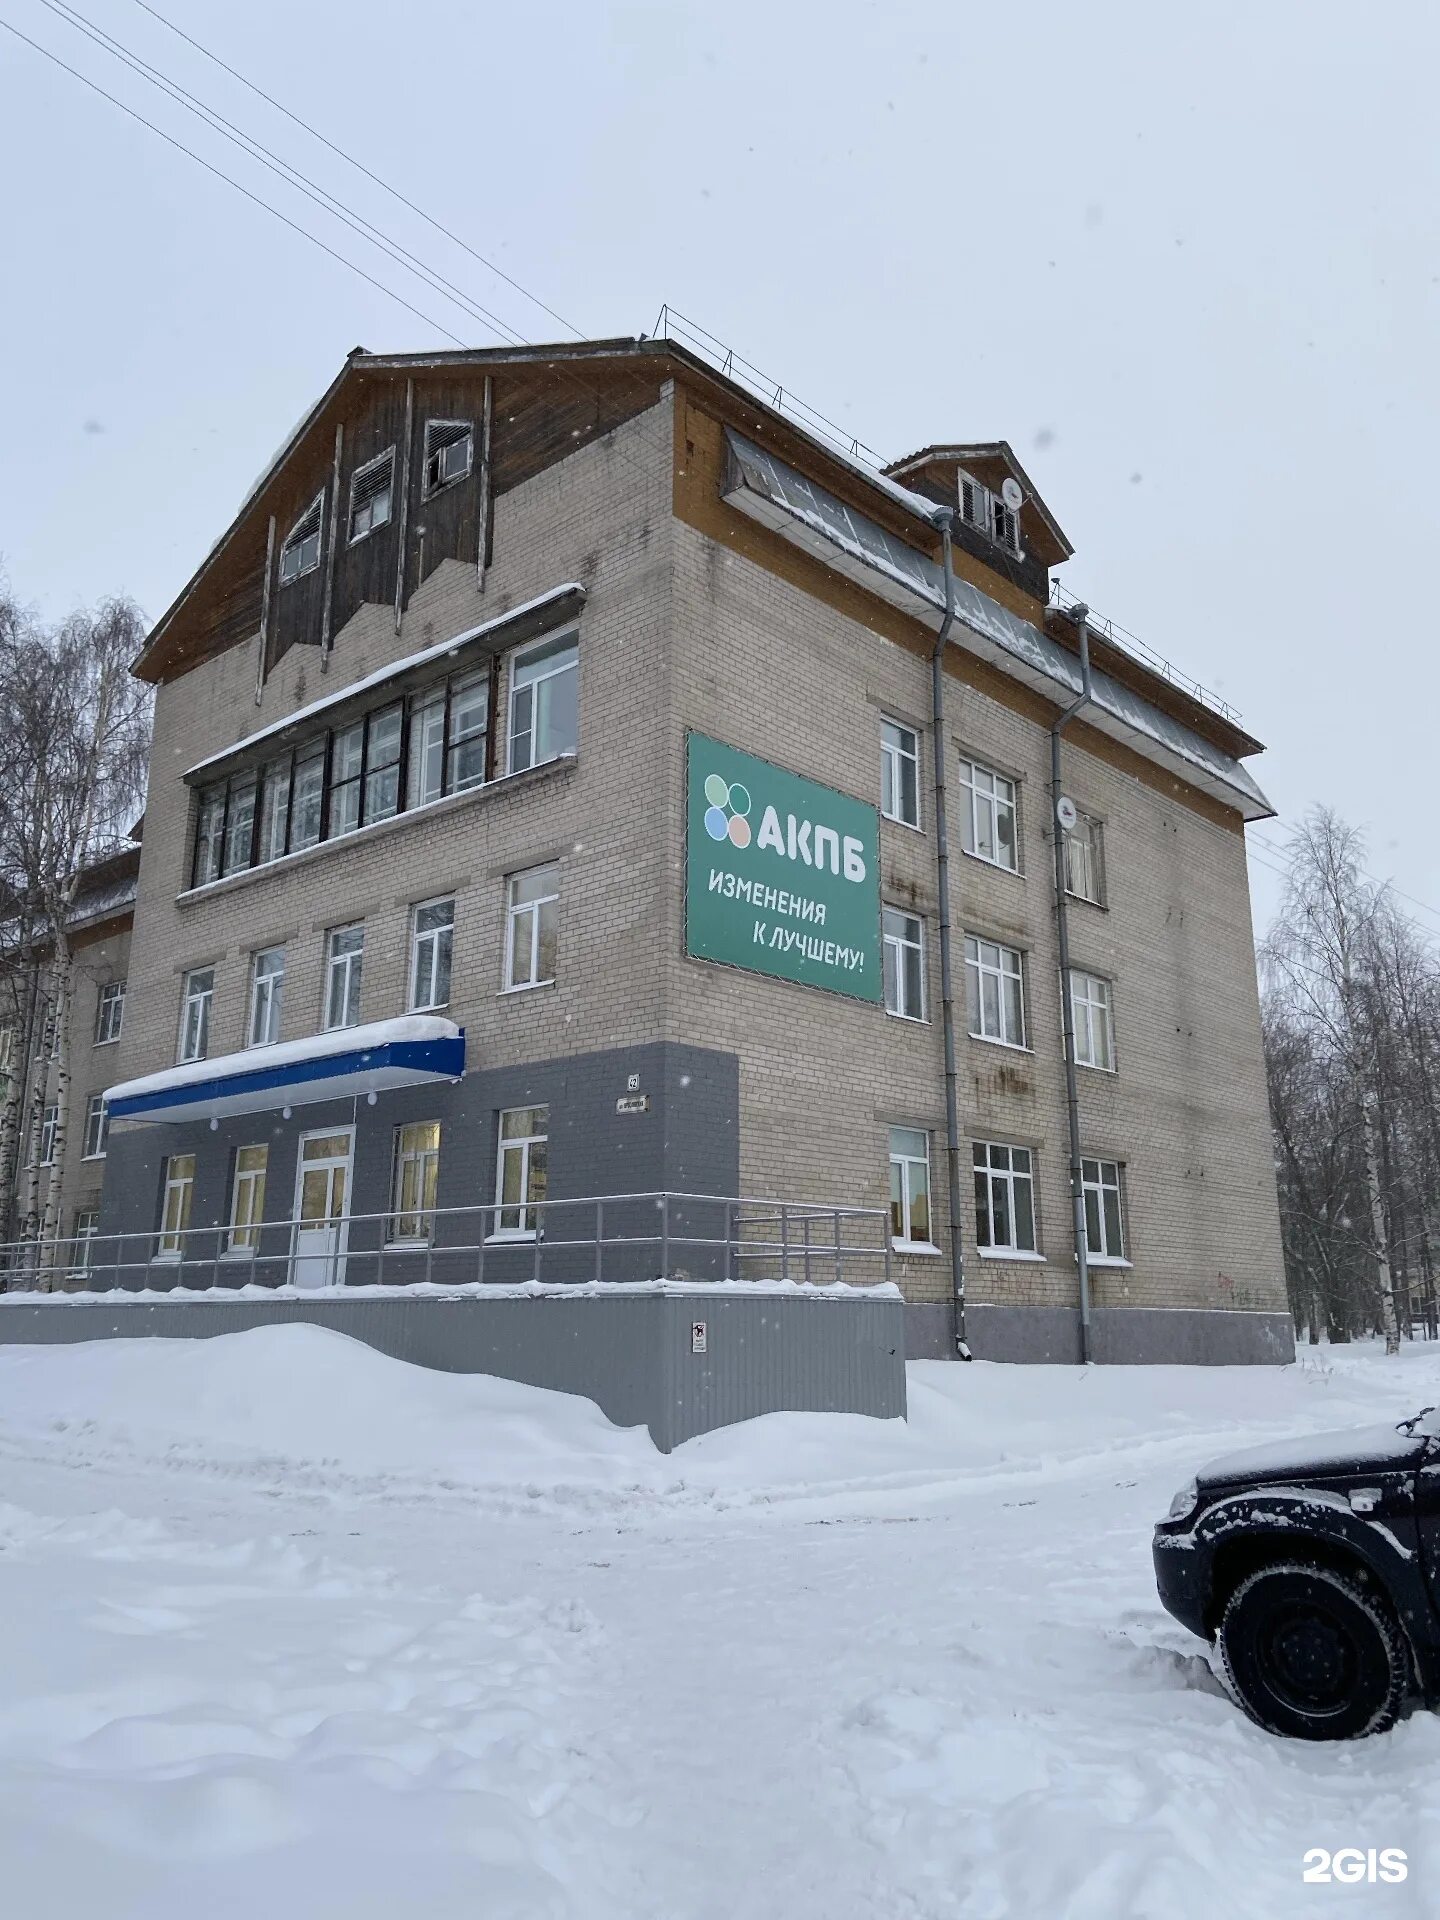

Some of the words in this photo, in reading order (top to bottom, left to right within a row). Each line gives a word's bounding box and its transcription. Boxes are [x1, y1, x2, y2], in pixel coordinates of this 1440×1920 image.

[757, 805, 866, 883] АКПБ
[708, 868, 827, 925] ИЗМЕНЕНИЯ
[753, 920, 765, 945] К
[768, 926, 865, 973] ЛУЧШЕМУ!
